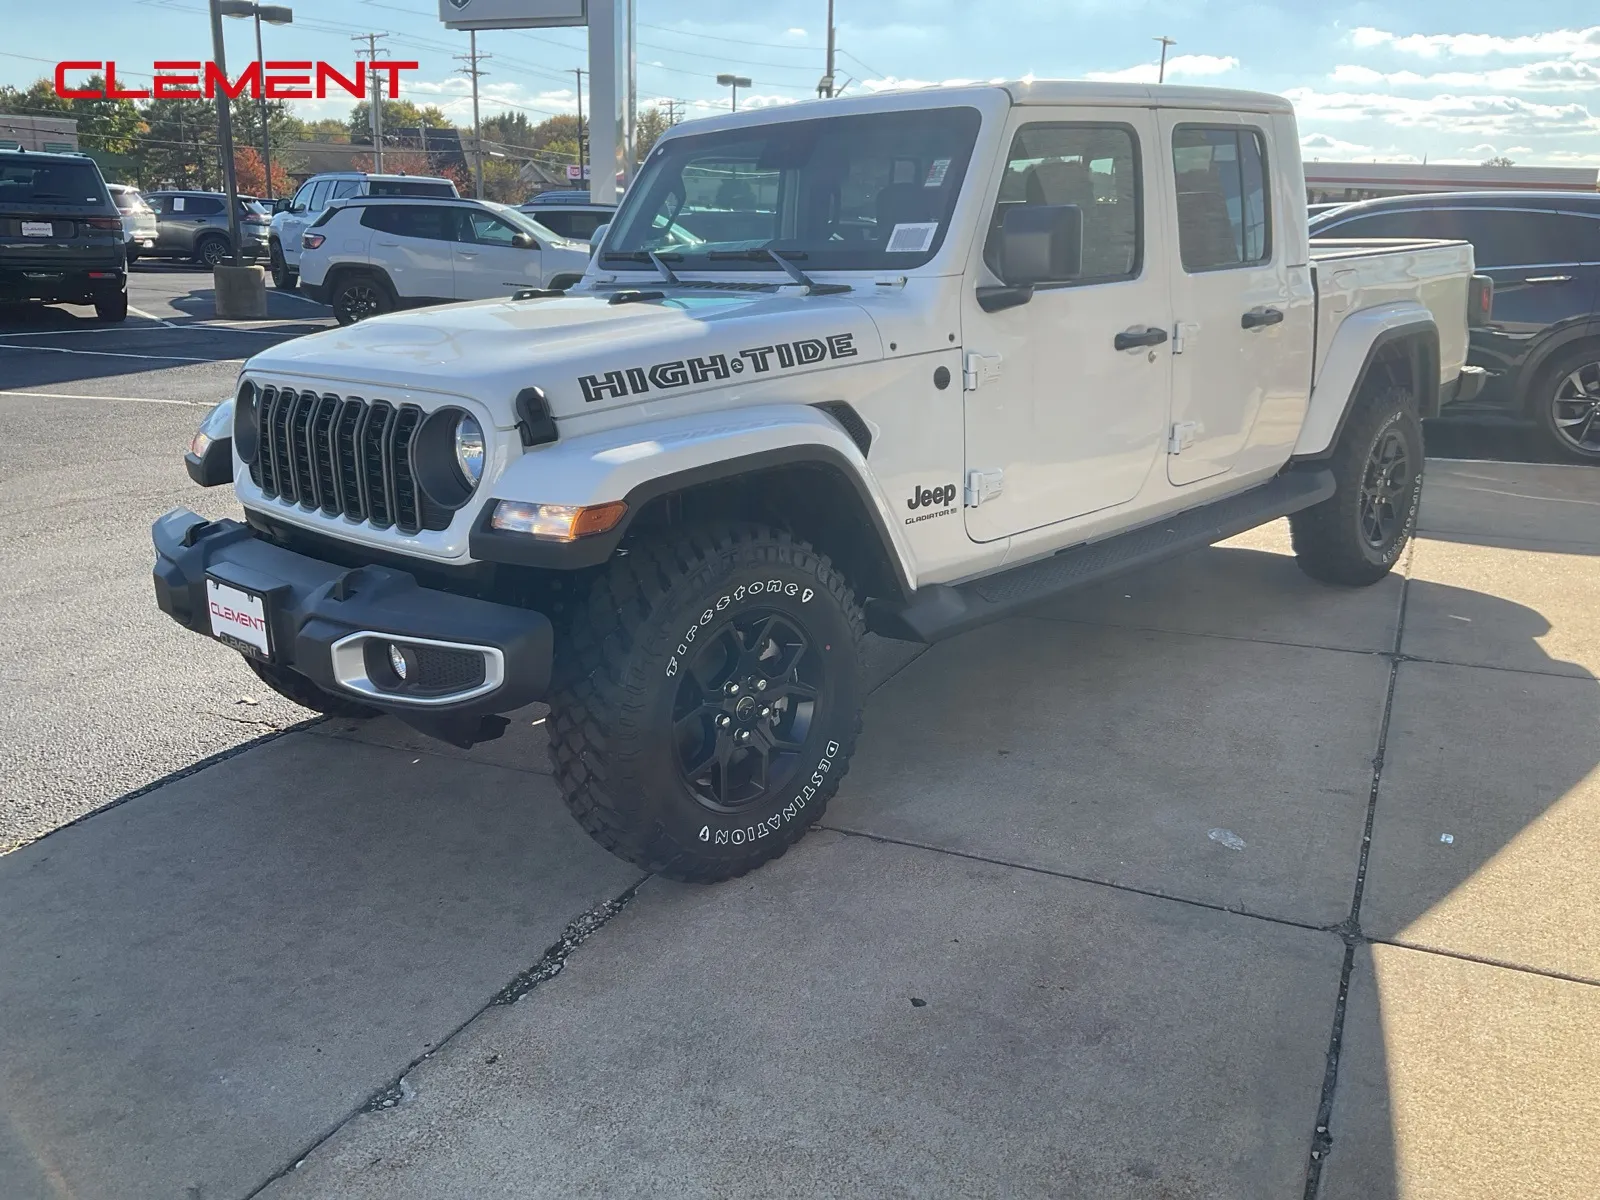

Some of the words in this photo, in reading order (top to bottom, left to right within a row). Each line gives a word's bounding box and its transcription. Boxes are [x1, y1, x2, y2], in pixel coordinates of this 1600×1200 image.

[577, 354, 730, 402] HIGH
[739, 333, 858, 373] TIDE
[907, 484, 956, 510] Jeep
[905, 509, 950, 525] GLADIATOR
[210, 602, 265, 632] CLEMENT
[666, 579, 798, 677] Firestone
[220, 634, 257, 658] CLEMENT
[715, 740, 839, 845] DESTINATION
